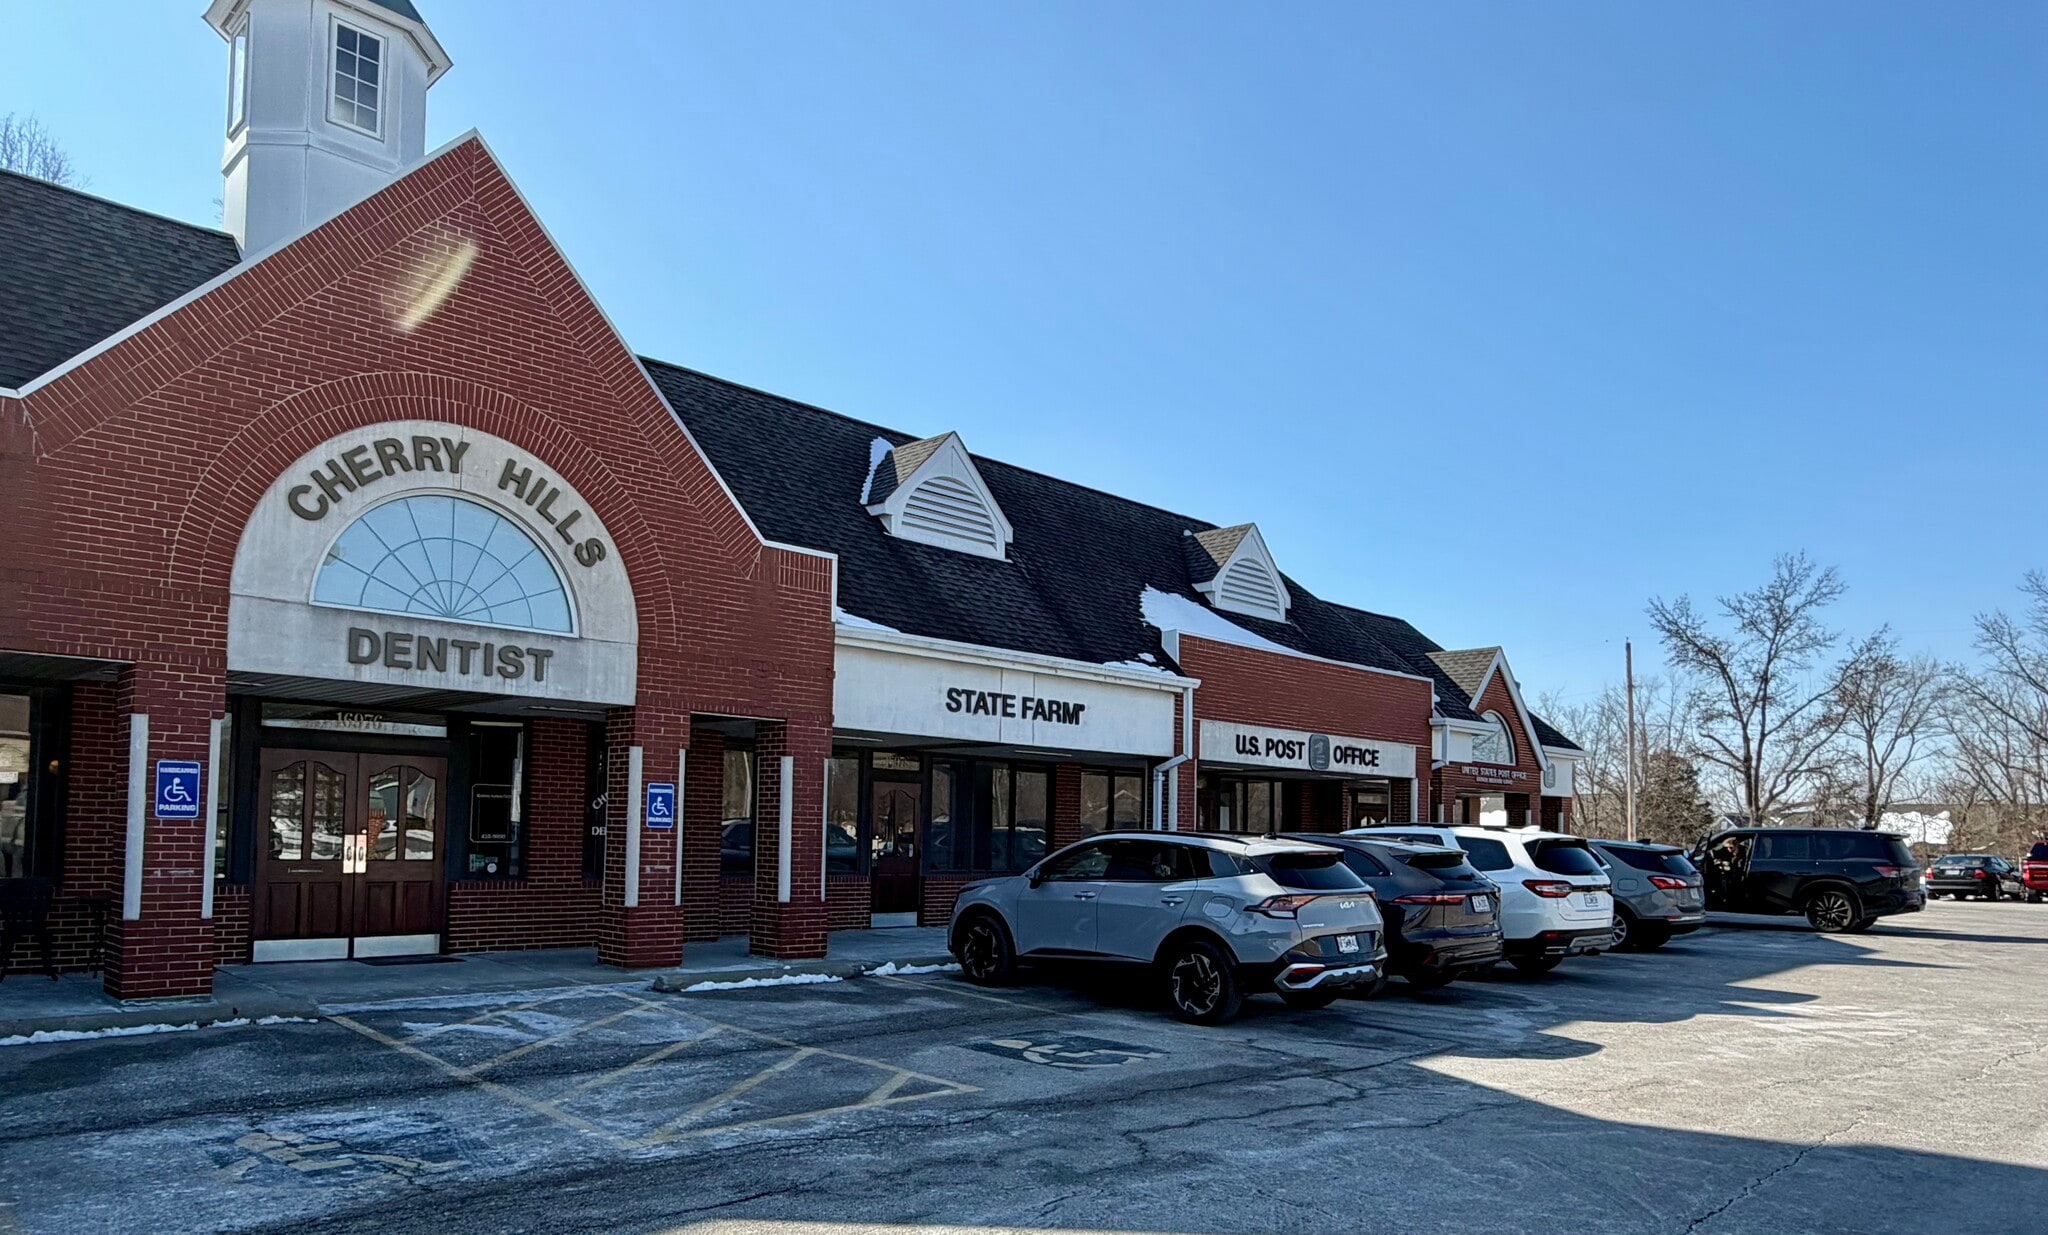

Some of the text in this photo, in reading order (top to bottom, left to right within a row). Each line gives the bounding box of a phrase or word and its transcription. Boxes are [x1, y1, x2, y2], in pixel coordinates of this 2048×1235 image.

[287, 435, 606, 569] CHERRY HILLS
[348, 627, 554, 682] DENTIST
[945, 687, 1017, 718] STATE
[335, 711, 383, 730] 16976
[1235, 734, 1380, 767] U.S. POST OFFICE
[1461, 765, 1527, 780] UNITED STATES POST OFFICE
